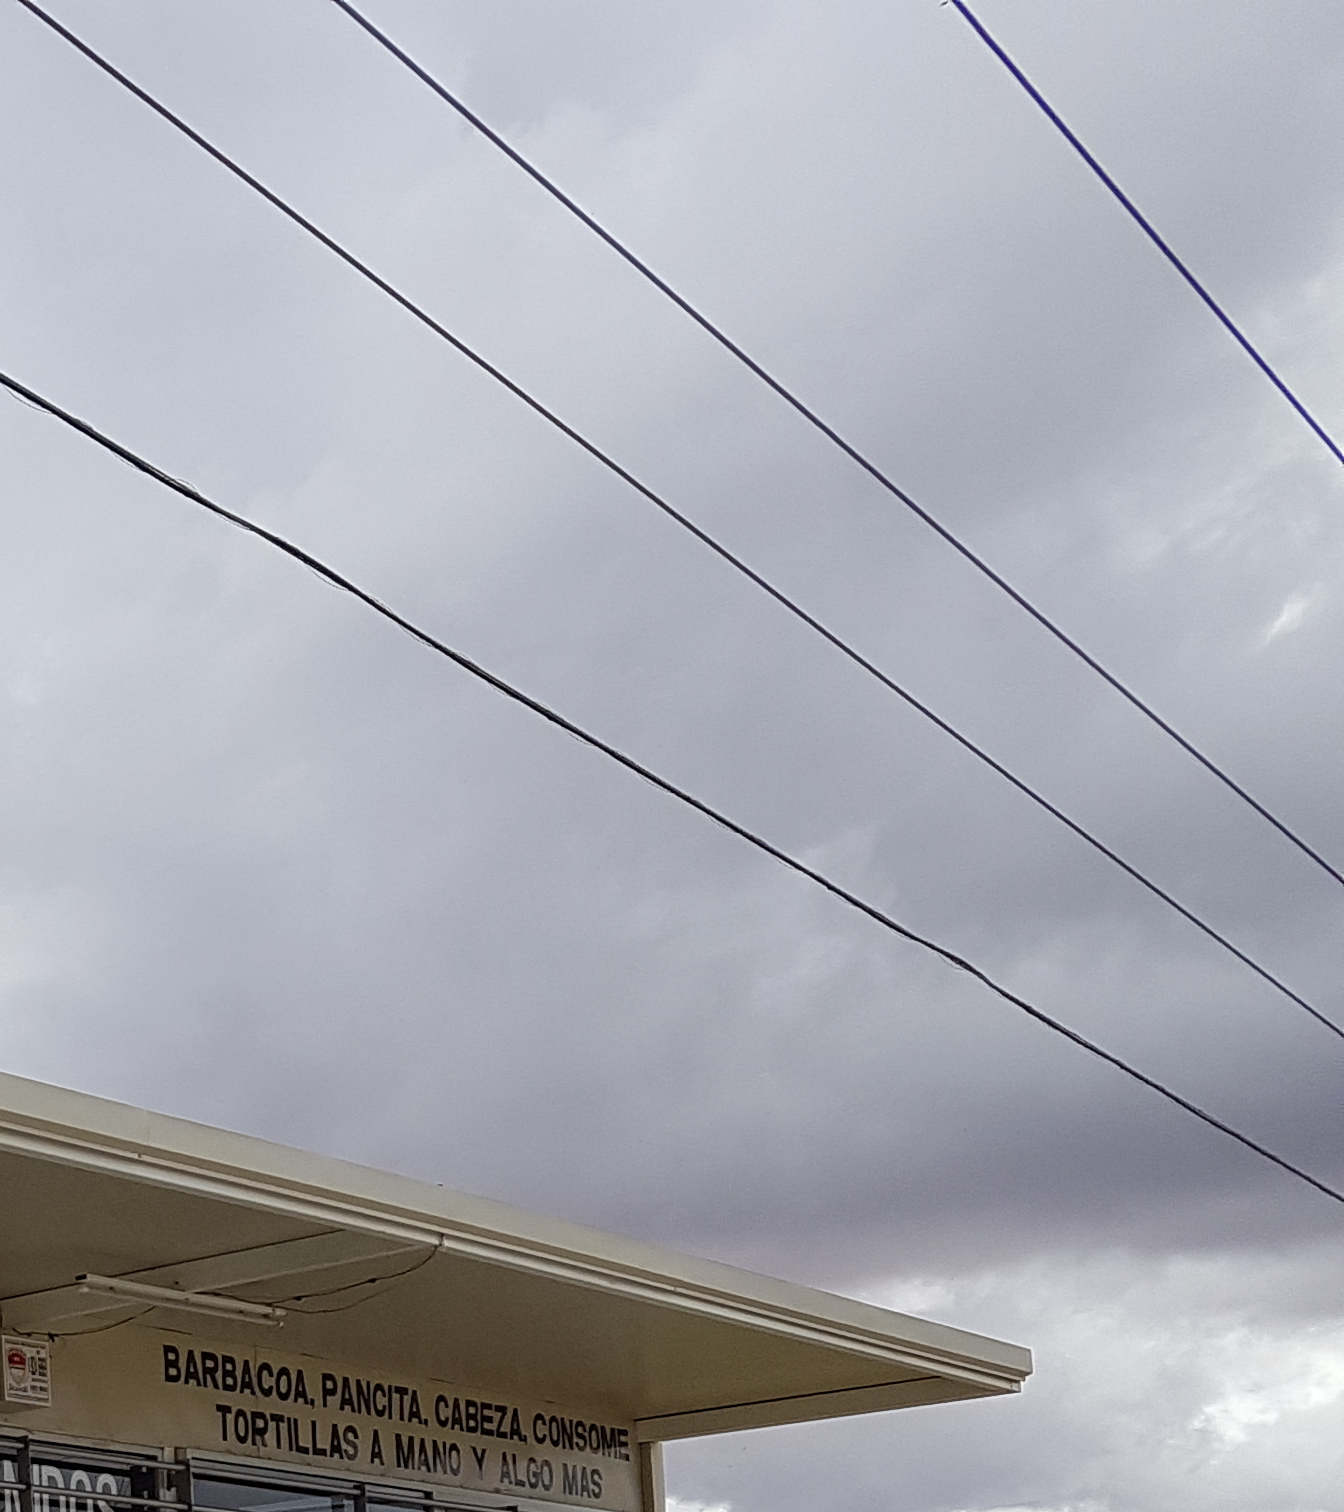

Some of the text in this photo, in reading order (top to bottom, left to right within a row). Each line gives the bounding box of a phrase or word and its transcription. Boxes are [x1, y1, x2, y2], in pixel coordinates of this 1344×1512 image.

[162, 1343, 631, 1463] BARBACOA, PANCITA, CABEZA, CONSOME
[215, 1403, 603, 1500] TORTILLAS A MANO Y ALGO MAS
